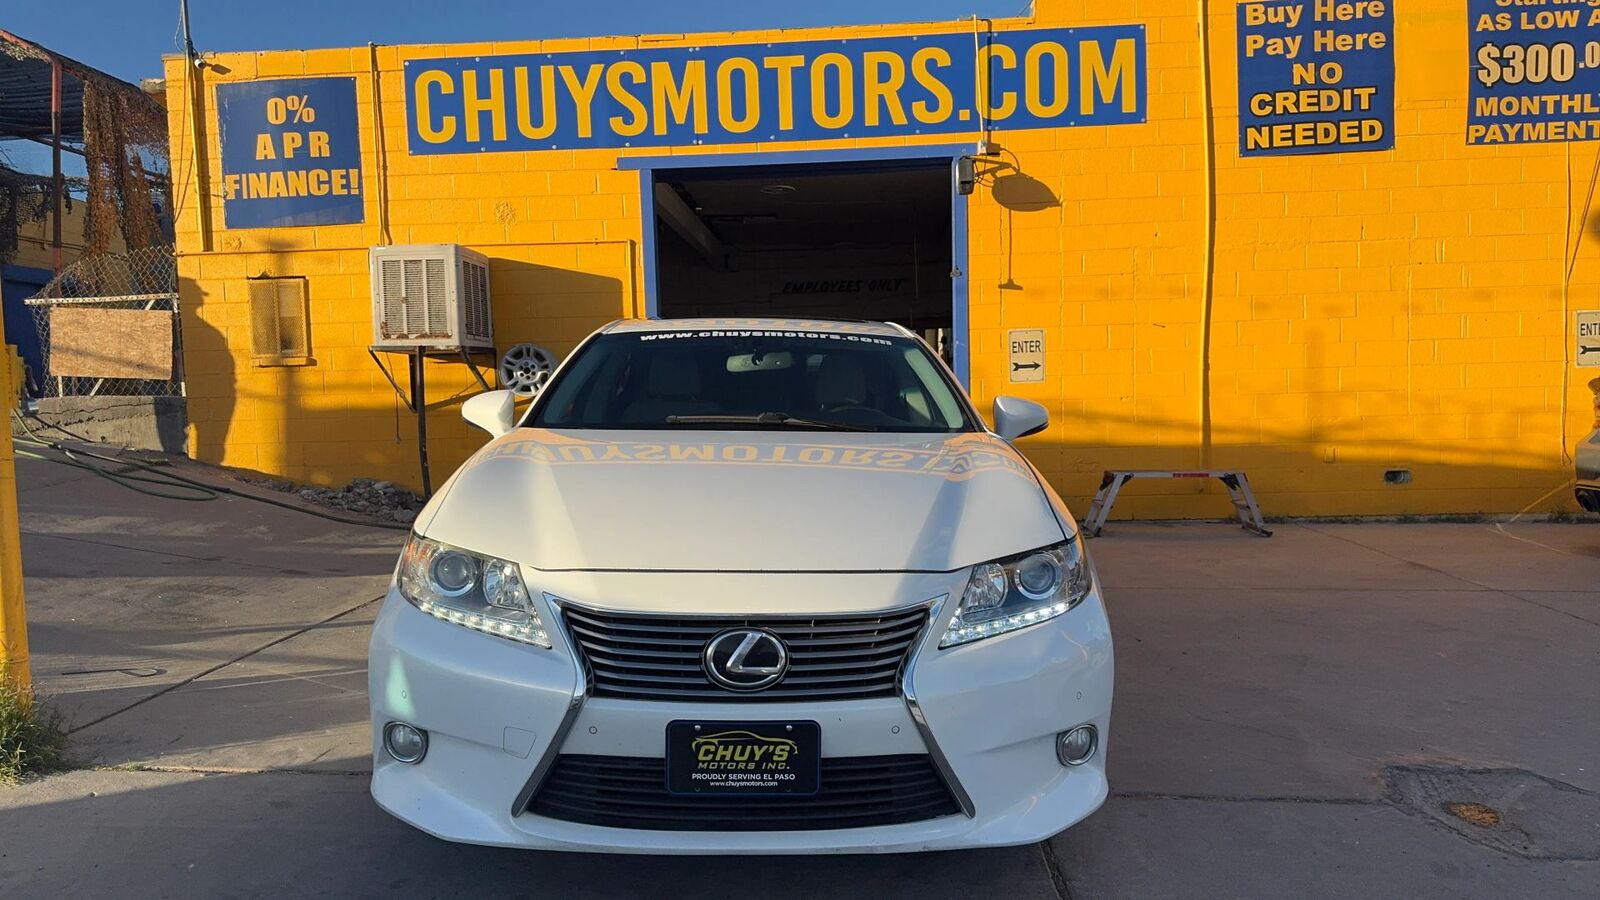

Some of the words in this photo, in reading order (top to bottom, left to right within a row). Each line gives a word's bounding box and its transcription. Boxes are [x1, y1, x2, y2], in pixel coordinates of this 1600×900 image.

[1245, 4, 1303, 28] Buy
[1314, 0, 1385, 21] Here
[1476, 12, 1512, 32] AS
[1520, 10, 1580, 30] LOW
[1245, 34, 1303, 59] Pay
[1314, 30, 1386, 52] Here
[1292, 61, 1343, 86] NO
[414, 38, 1137, 144] CHUYSMOTORS.COM
[1250, 87, 1376, 117] CREDIT
[266, 94, 316, 125] 0%
[1475, 93, 1600, 117] MONTHL
[1246, 119, 1384, 150] NEEDED
[224, 168, 359, 200] FINANCE!
[781, 279, 863, 295] EMPLOYEES
[867, 278, 905, 293] ONLY
[640, 329, 893, 346] www.chuysmotors.com
[1580, 323, 1600, 336] ENT
[1012, 340, 1041, 353] ENTER
[697, 744, 790, 761] CHUY'S
[697, 762, 755, 770] MOTORS
[762, 762, 790, 770] INC.
